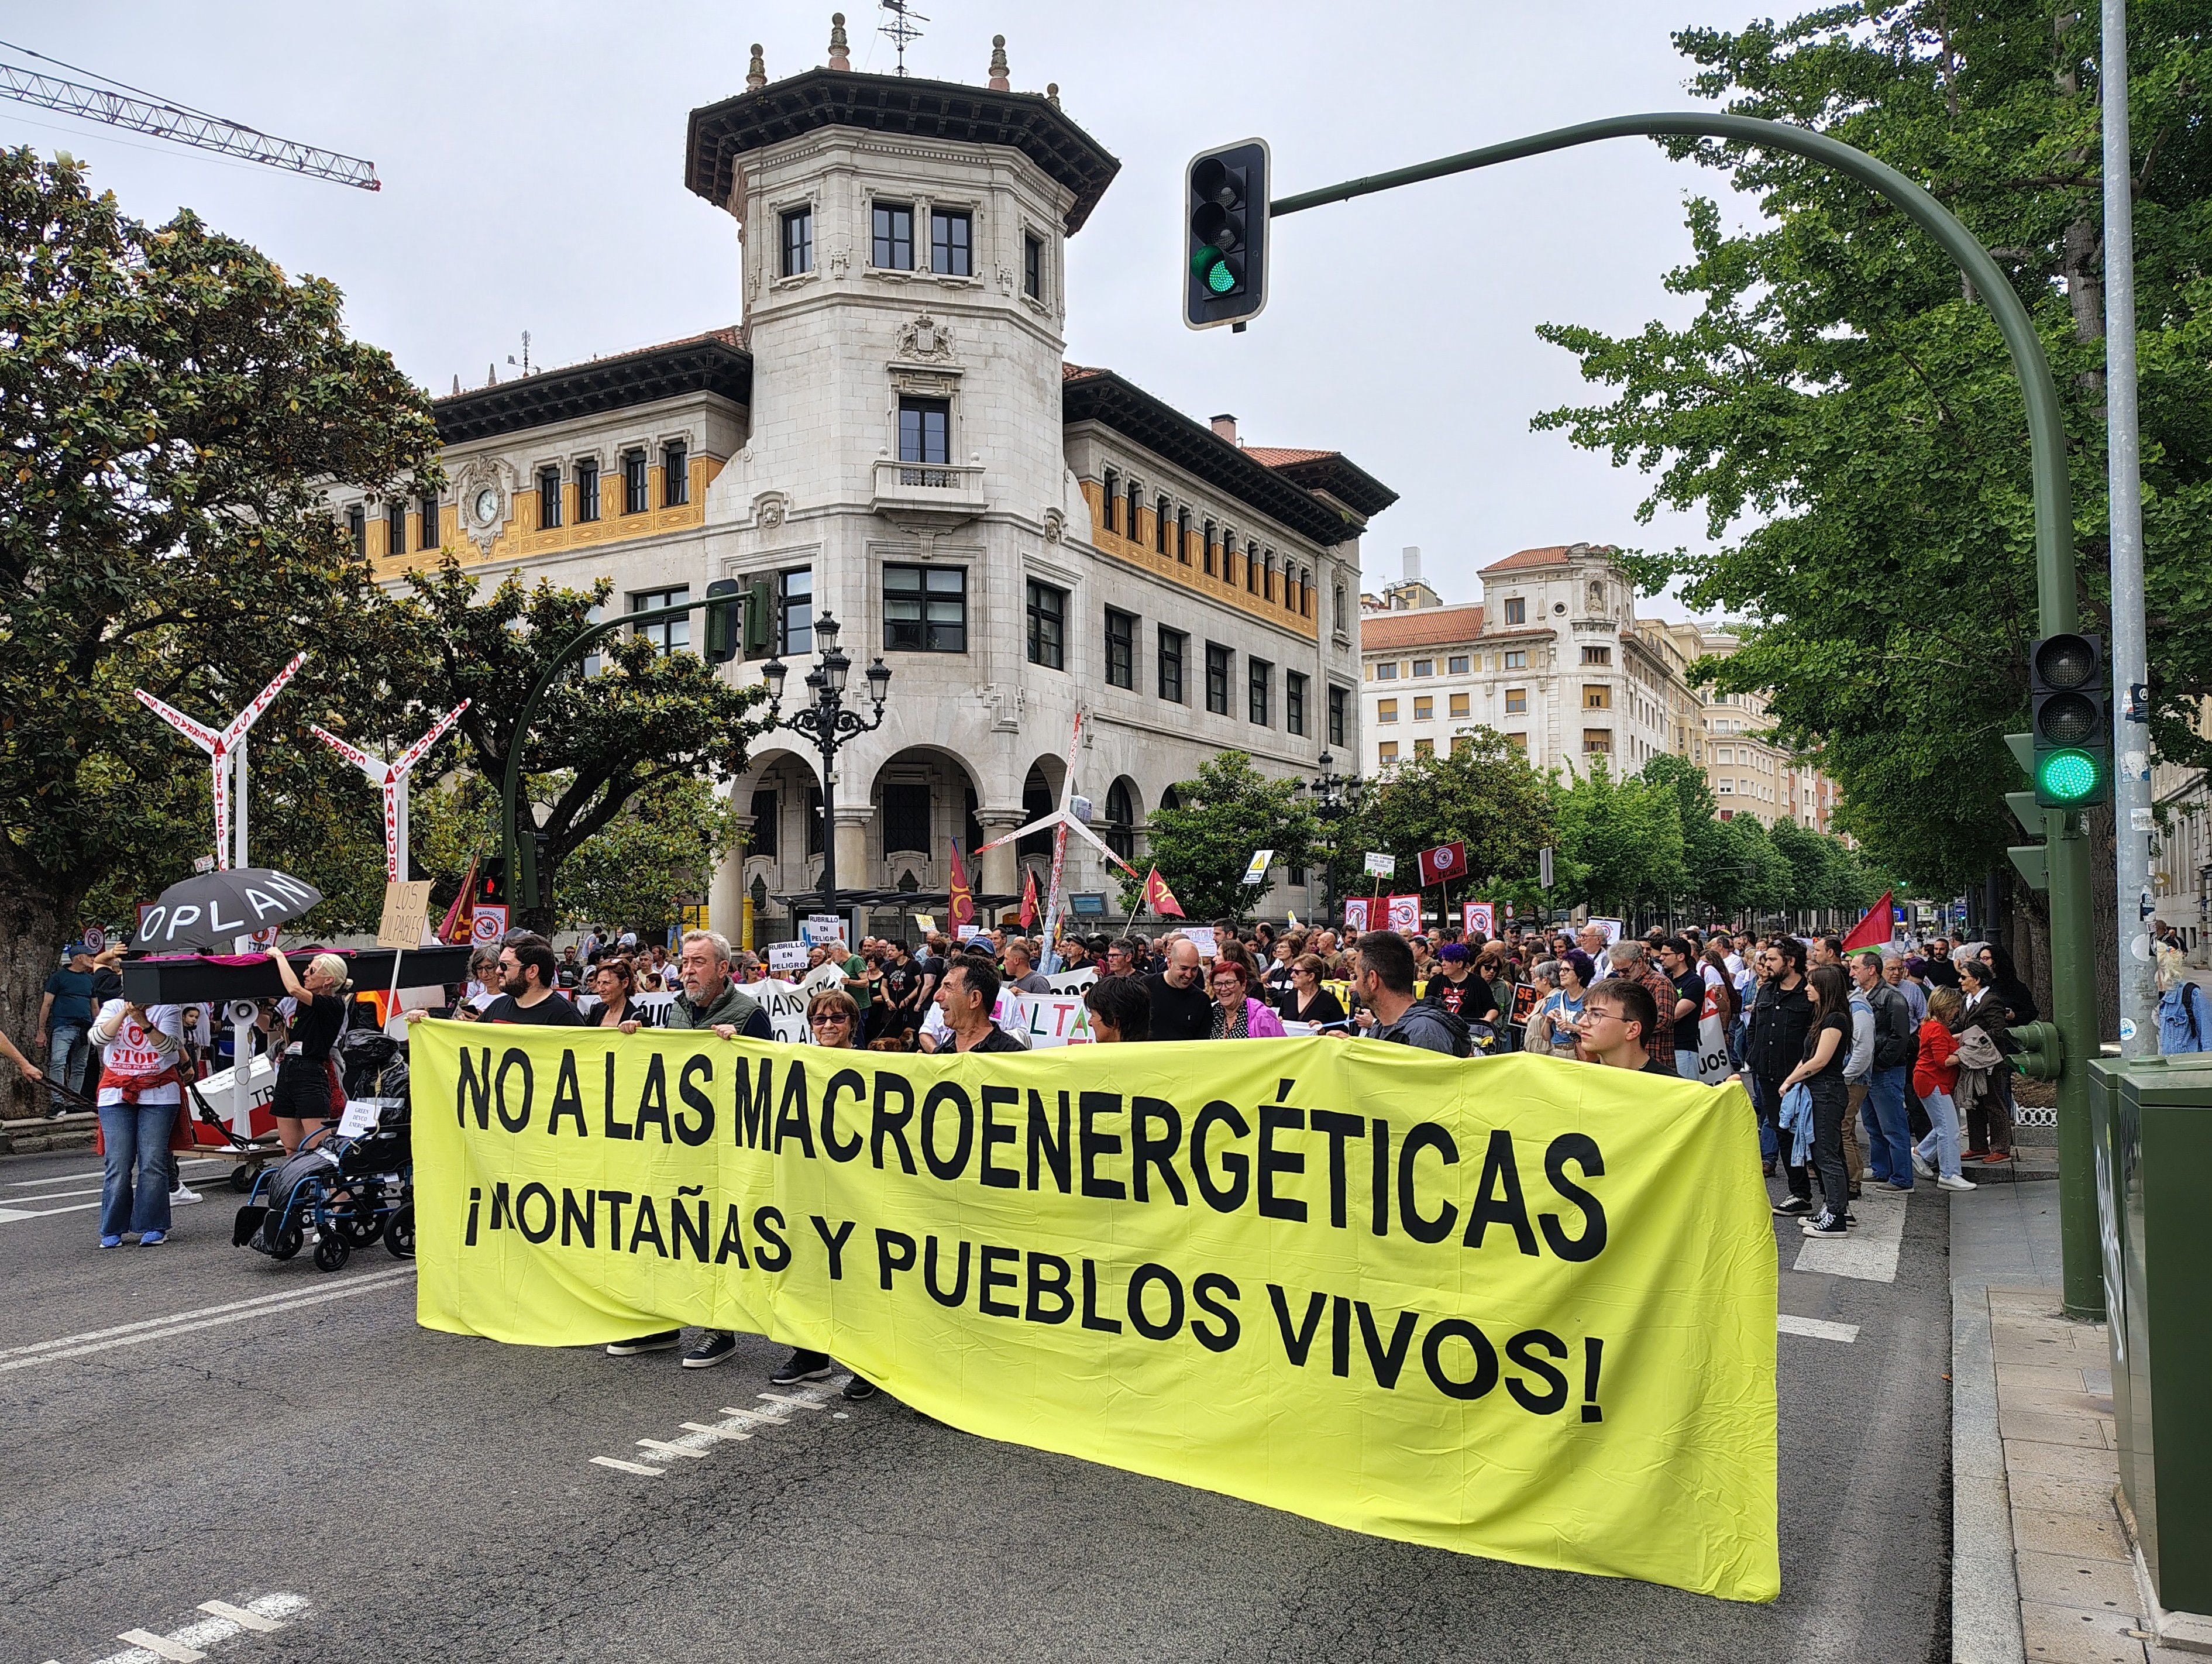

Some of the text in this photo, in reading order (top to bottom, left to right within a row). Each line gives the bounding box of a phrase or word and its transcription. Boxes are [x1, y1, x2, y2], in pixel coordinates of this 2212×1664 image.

[395, 883, 419, 910] LOS
[379, 914, 423, 945] CULPABLES
[769, 941, 806, 950] RUBRILLO
[772, 962, 806, 970] PELIGRO
[1517, 987, 1533, 1001] SE
[112, 1048, 159, 1064] STOP
[457, 1047, 1607, 1263] NO A LAS MACROENERGÉTICAS
[810, 1215, 856, 1281] Y
[875, 1228, 1241, 1353] PUEBLOS
[1265, 1283, 1604, 1424] VIVOS!
